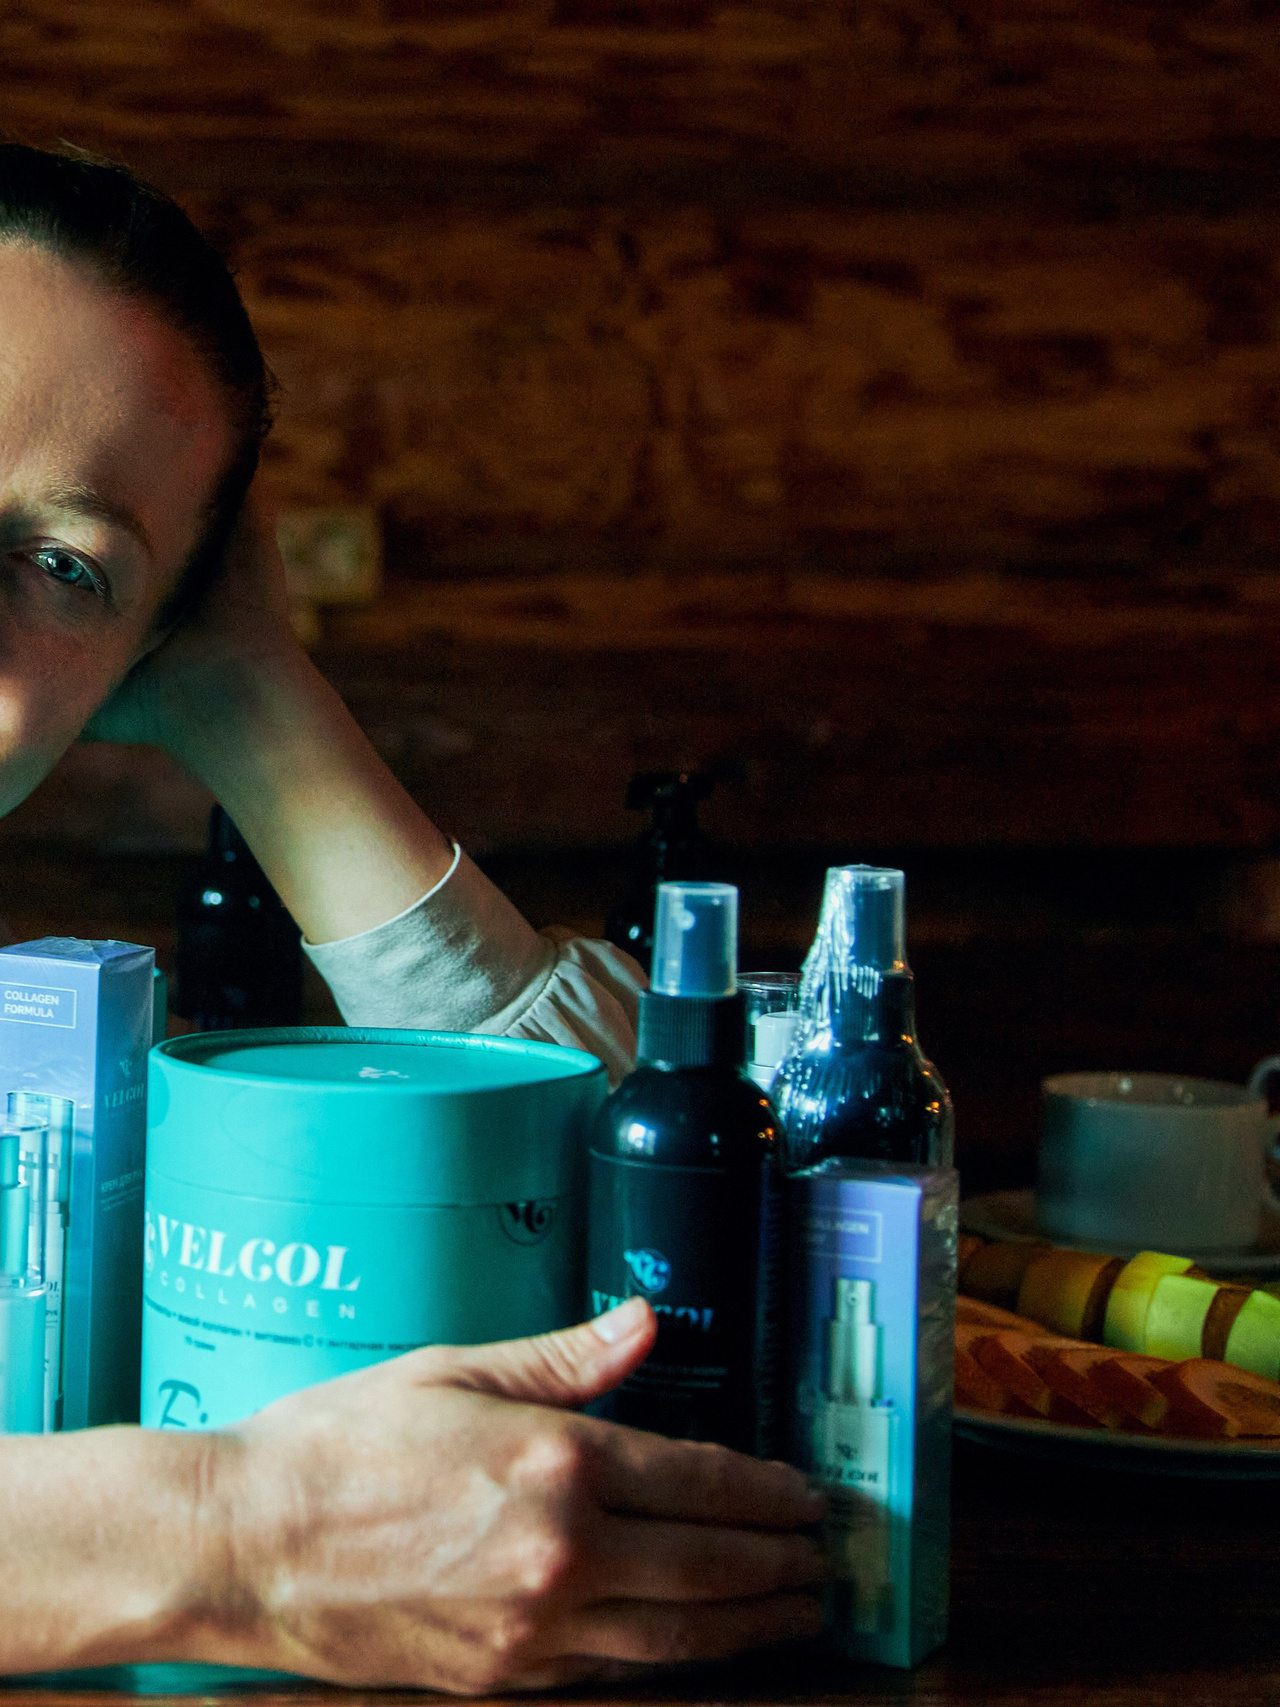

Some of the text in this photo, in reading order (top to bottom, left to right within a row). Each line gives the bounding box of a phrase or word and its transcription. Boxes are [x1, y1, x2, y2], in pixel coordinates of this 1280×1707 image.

[4, 990, 59, 1006] COLLAGEN
[4, 1003, 54, 1019] FORMULA
[158, 1213, 362, 1291] VELGOL
[159, 1270, 356, 1320] COLLAGEN
